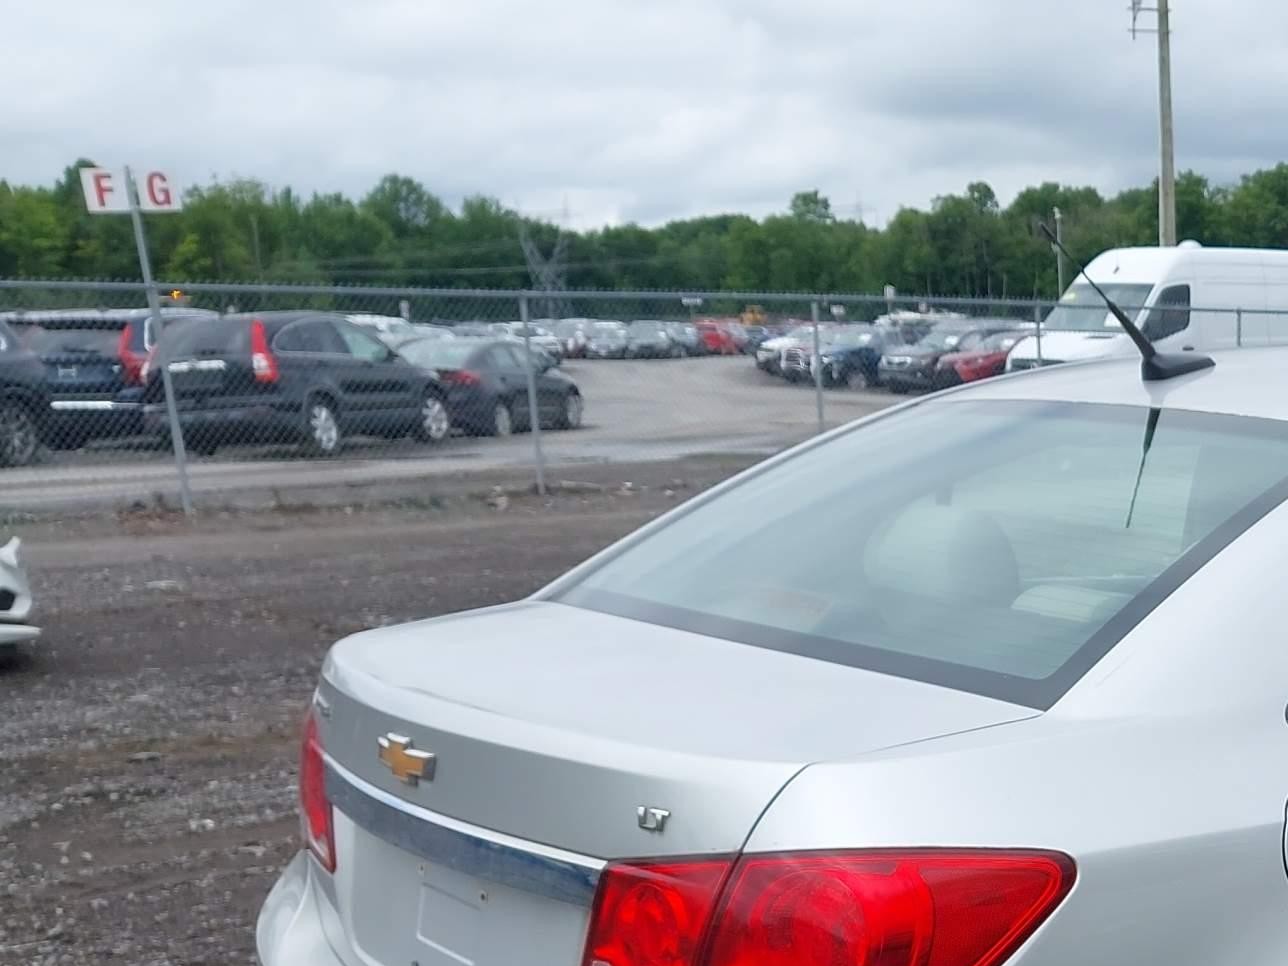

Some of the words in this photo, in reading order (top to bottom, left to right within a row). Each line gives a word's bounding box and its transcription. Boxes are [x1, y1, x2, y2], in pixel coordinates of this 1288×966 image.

[93, 172, 113, 207] F
[147, 171, 172, 206] G
[636, 805, 671, 833] LT
